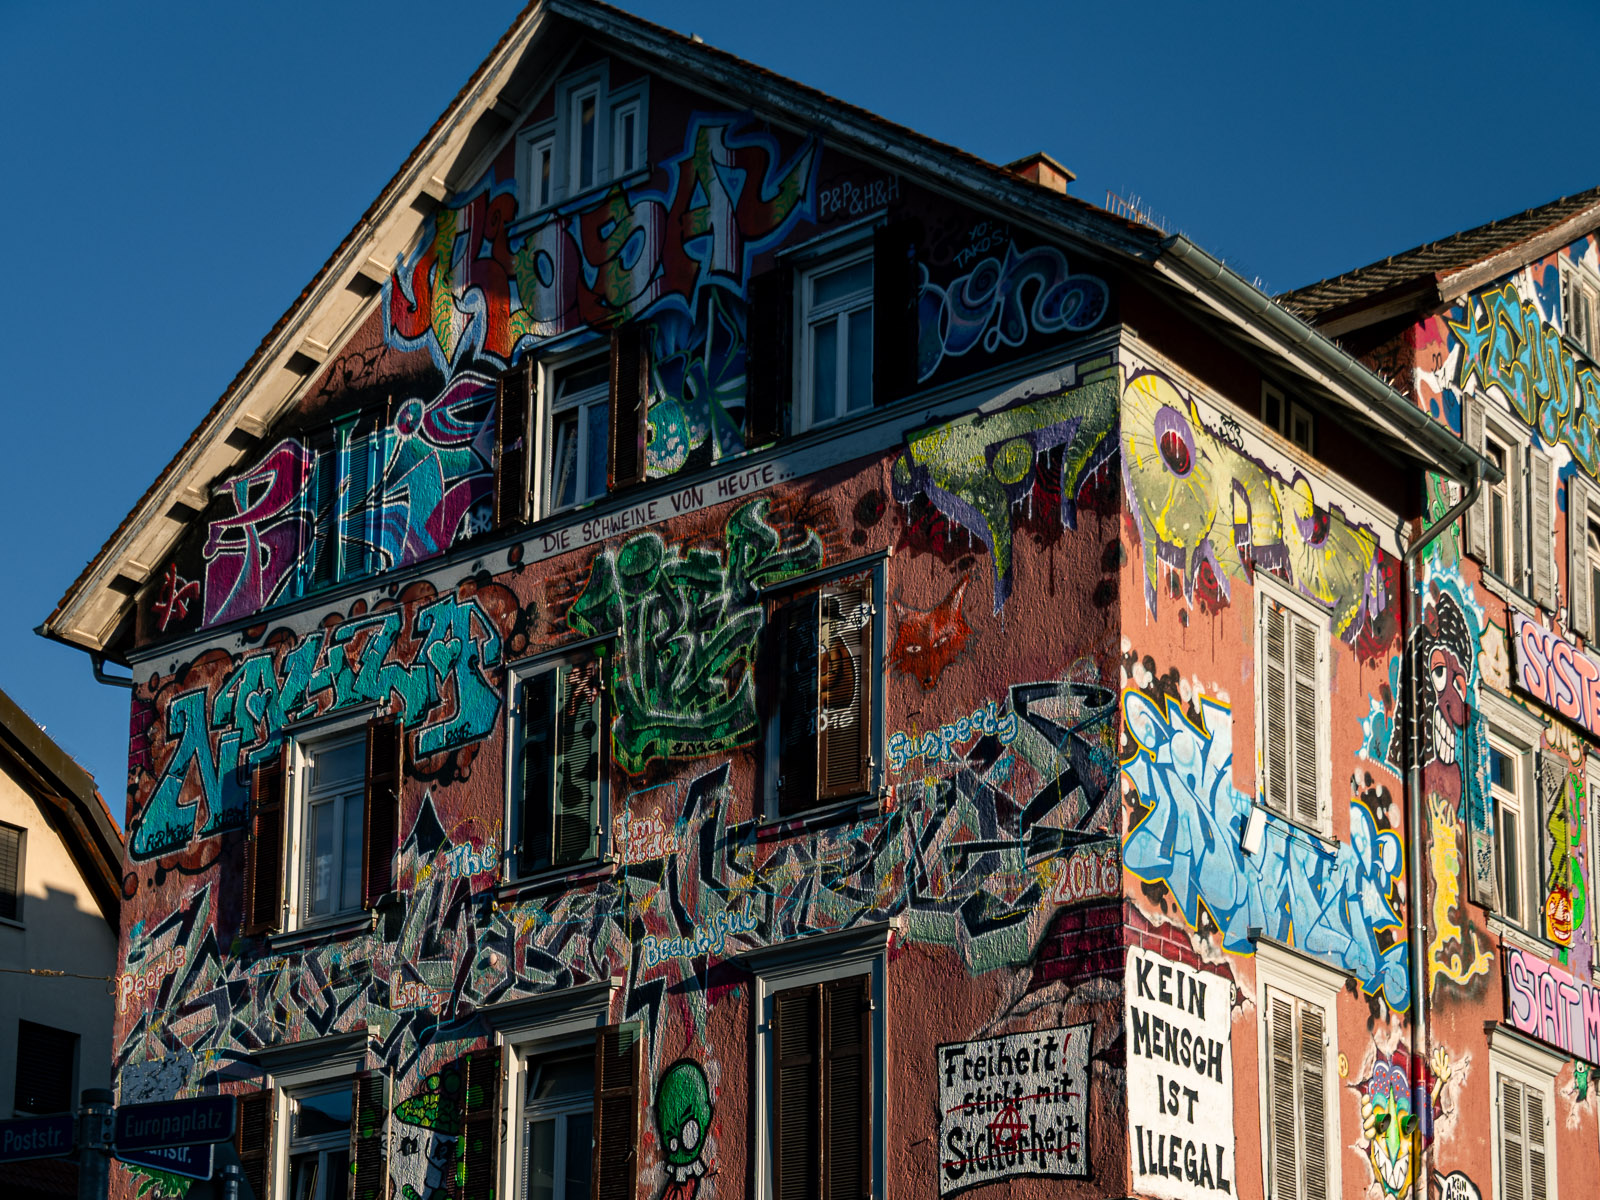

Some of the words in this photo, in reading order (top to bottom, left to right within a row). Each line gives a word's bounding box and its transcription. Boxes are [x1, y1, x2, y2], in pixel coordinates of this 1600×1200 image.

[539, 530, 570, 553] DIE
[582, 501, 658, 543] SCHWEINE
[671, 486, 703, 512] VON
[447, 841, 496, 879] The
[1053, 851, 1119, 905] 2016
[119, 945, 186, 1014] People
[1135, 957, 1207, 1022] KEIN
[1130, 1005, 1223, 1084] MENSCH
[124, 1107, 223, 1140] Europaplatz
[963, 1081, 1023, 1116] stirbt
[1036, 1073, 1073, 1105] mit
[1157, 1074, 1199, 1124] IST
[4, 1127, 64, 1151] Poststr.
[944, 1115, 1079, 1179] Sicherheit
[1135, 1125, 1231, 1195] ILLEGAL
